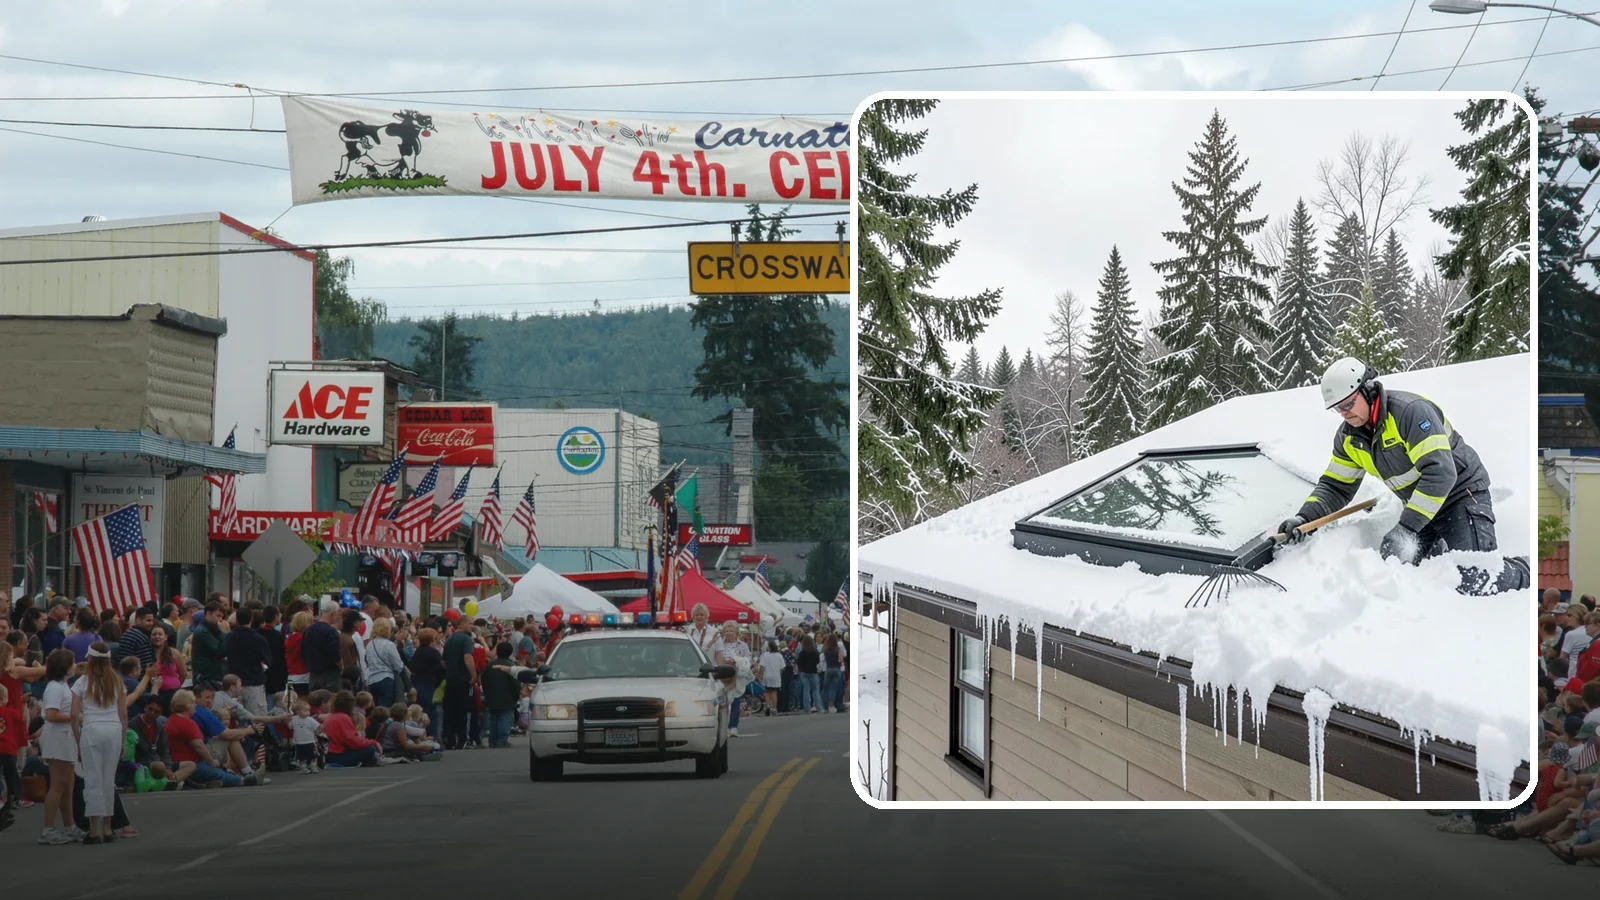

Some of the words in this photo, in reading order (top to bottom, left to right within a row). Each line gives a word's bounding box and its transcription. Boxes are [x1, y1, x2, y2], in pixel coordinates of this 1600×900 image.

[481, 141, 605, 193] JULY
[632, 149, 747, 198] 4th.
[697, 254, 850, 280] CROSSWA
[283, 380, 374, 420] ACE
[405, 408, 453, 422] CEDAR
[283, 421, 371, 436] Hardware
[353, 467, 386, 480] Simpl
[83, 485, 93, 494] St.
[95, 485, 124, 495] Vincent
[126, 486, 136, 495] de
[137, 486, 155, 495] Paul
[212, 516, 331, 536] HARDARE
[688, 526, 741, 535] CRNATION
[699, 535, 731, 543] GLASS
